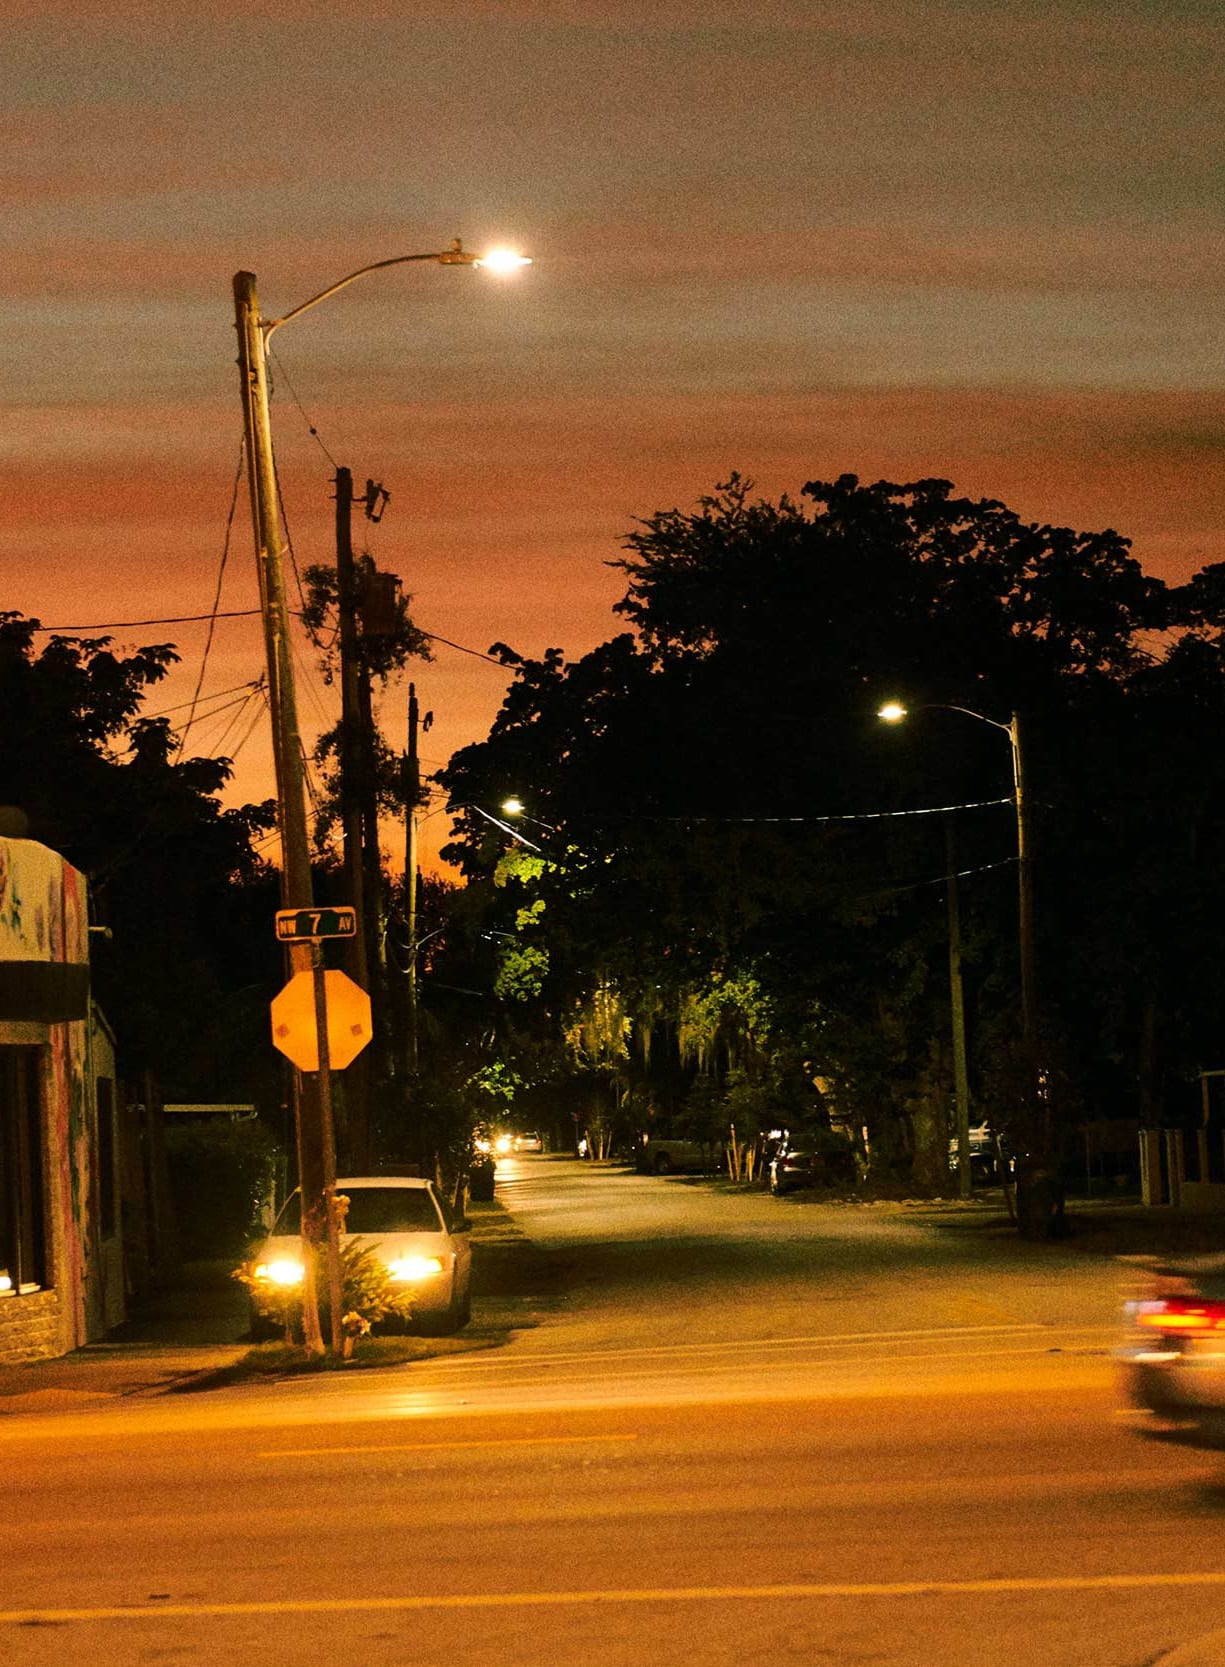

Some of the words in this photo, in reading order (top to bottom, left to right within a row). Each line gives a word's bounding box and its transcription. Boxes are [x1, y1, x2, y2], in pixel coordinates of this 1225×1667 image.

[279, 919, 296, 935] NW
[309, 913, 321, 934] 7
[338, 916, 352, 931] AV
